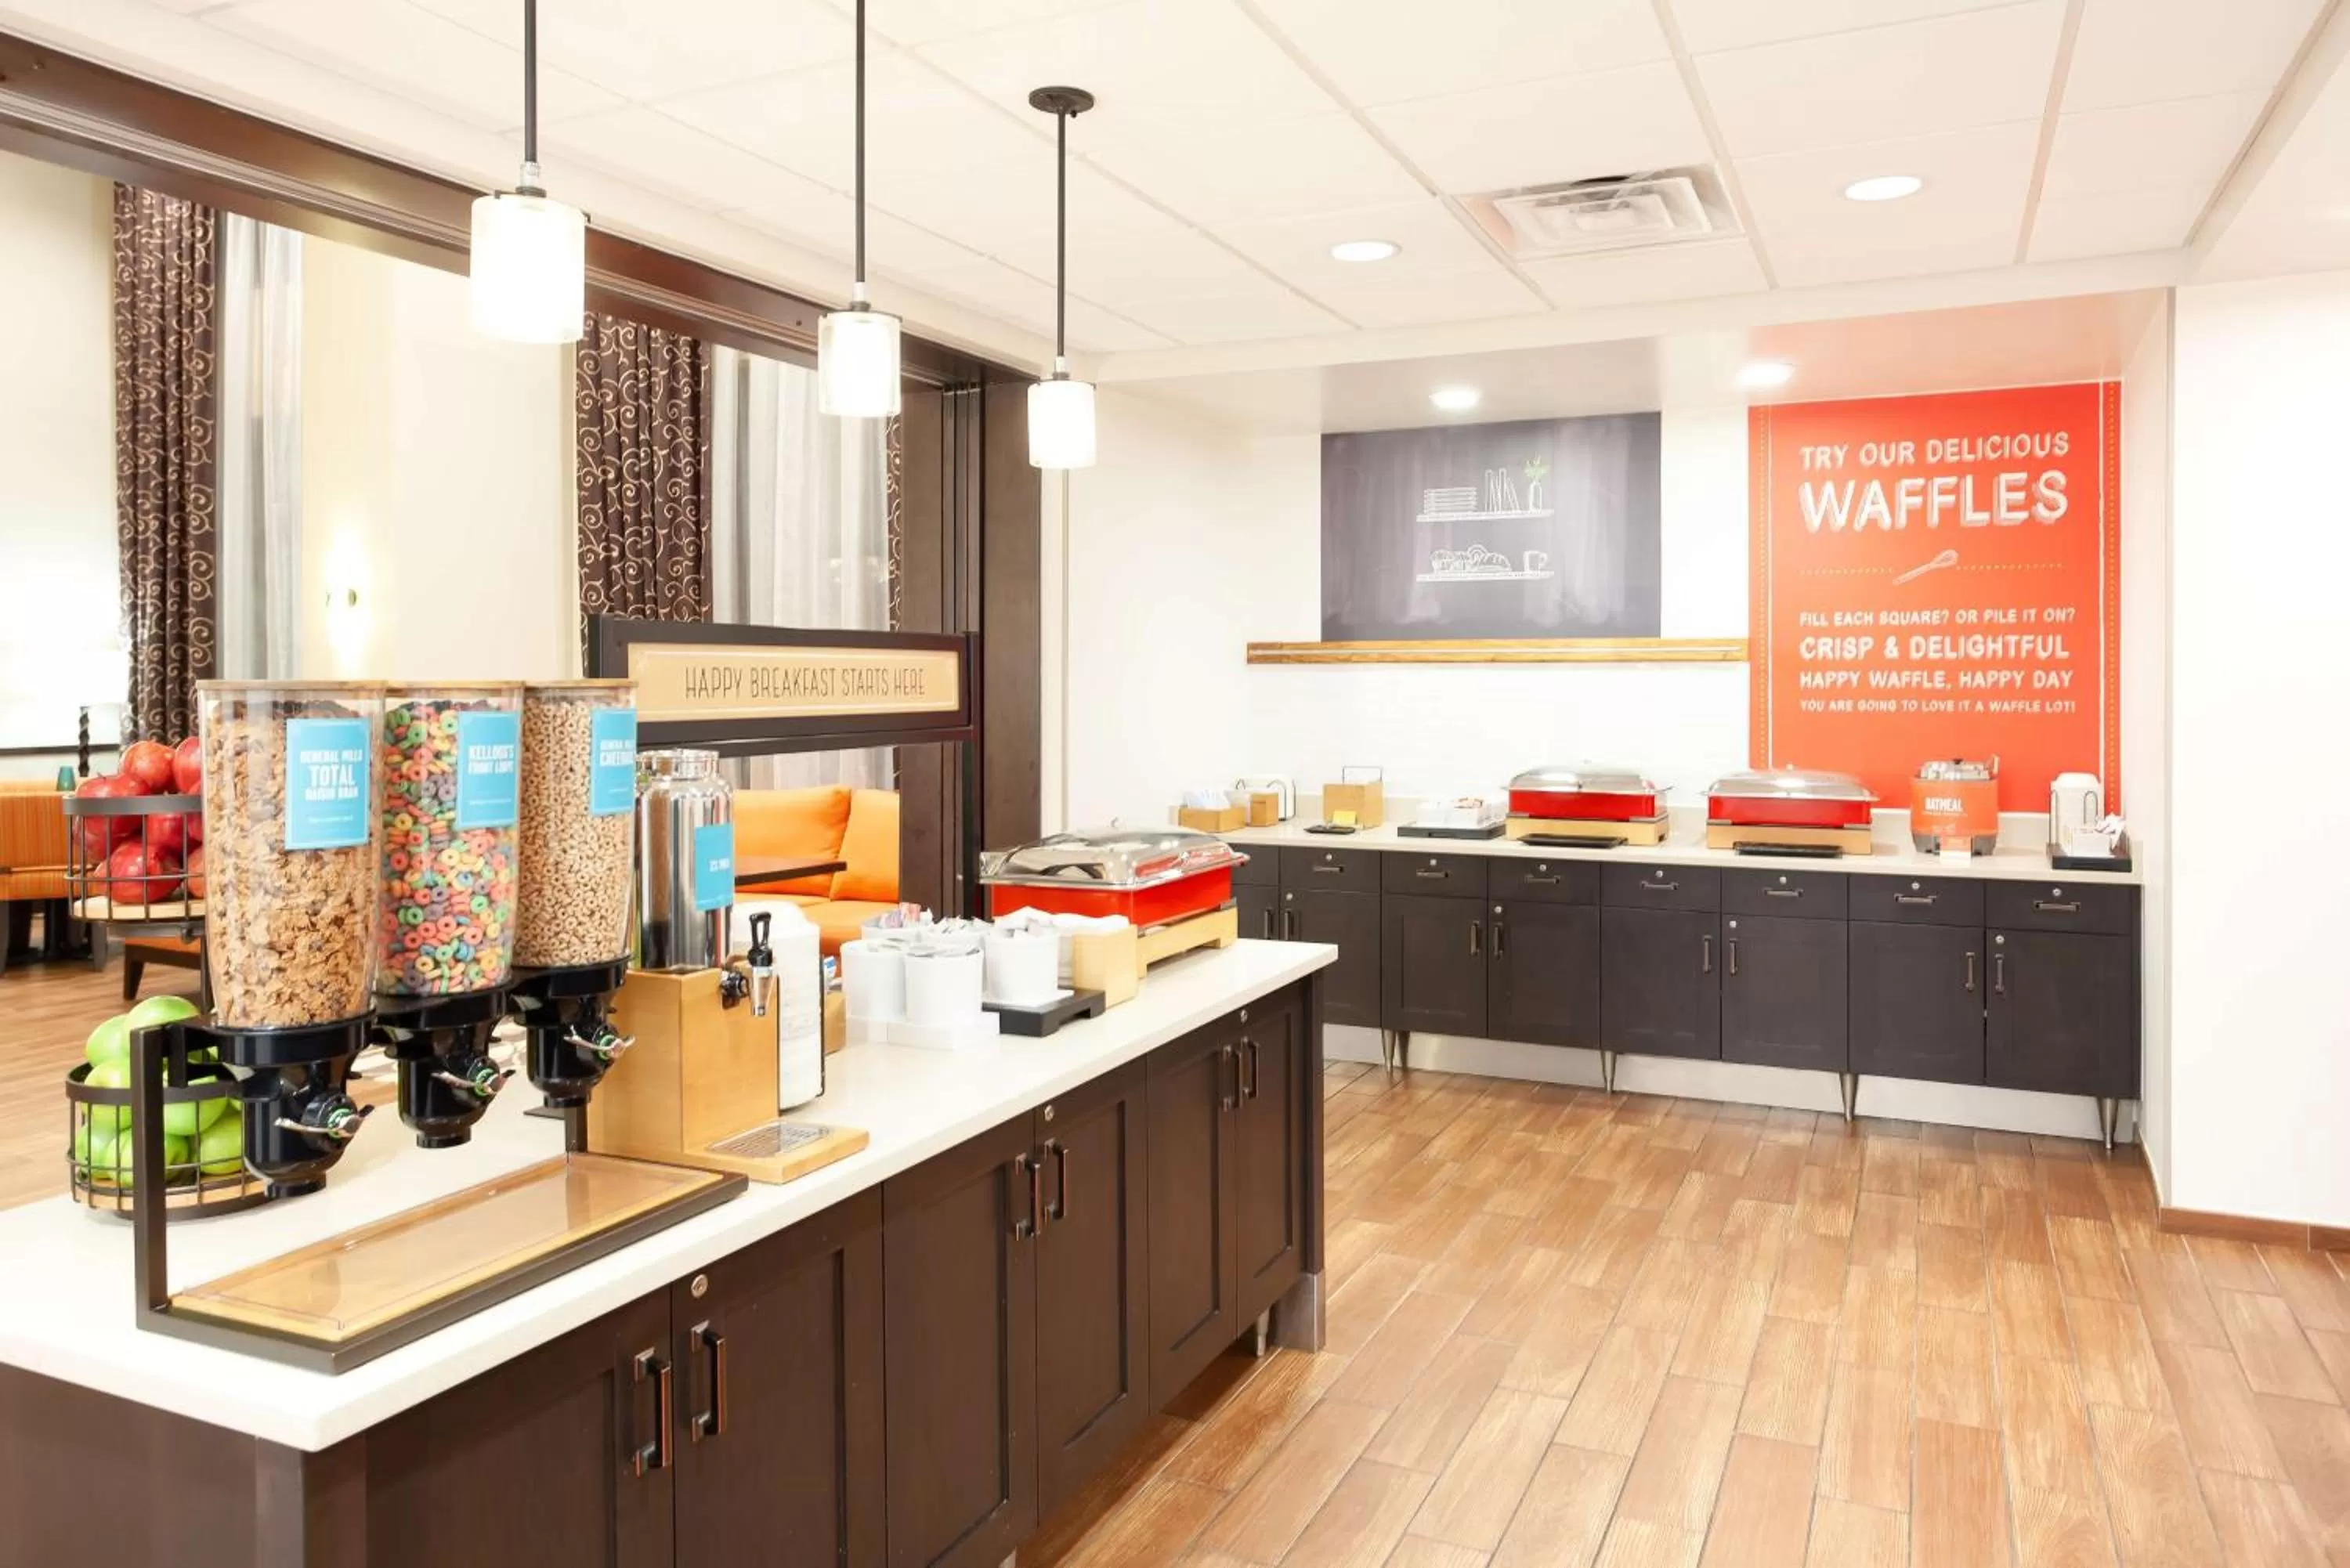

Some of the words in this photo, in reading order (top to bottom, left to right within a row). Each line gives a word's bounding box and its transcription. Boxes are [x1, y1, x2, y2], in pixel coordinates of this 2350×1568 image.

[1800, 444, 1849, 470] TRY
[1859, 441, 1915, 468] OUR
[1926, 432, 2069, 464] DELICIOUS
[1799, 469, 2069, 533] WAFFLES
[1799, 611, 1829, 627] FILL
[1834, 611, 1875, 627] EACH
[1879, 609, 1950, 626] SQUARE?
[1955, 609, 1978, 624] OR
[1983, 608, 2018, 623] PILE
[2023, 608, 2037, 623] IT
[2043, 607, 2076, 623] ON?
[1799, 636, 1875, 660] CRISP
[1883, 635, 1899, 659] &
[1909, 634, 2070, 660] DELIGHTFUL
[685, 667, 743, 699] HAPPY
[750, 667, 836, 699] BREAKFAST
[841, 667, 890, 697] STARTS
[893, 667, 926, 695] HERE
[1799, 670, 1861, 690] HAPPY
[1959, 670, 2026, 689] HAPPY
[2033, 670, 2073, 689] DAY
[1799, 699, 1824, 713] YOU
[1828, 699, 1853, 713] ARE
[1857, 699, 1897, 713] GOING
[1901, 699, 1918, 713] TO
[1922, 699, 1954, 713] LOVE
[1958, 699, 1971, 713] IT
[1975, 699, 1984, 713] A
[1989, 699, 2041, 713] WAFFLE
[308, 764, 356, 787] TOTAL
[1925, 796, 1964, 812] OATMEAL
